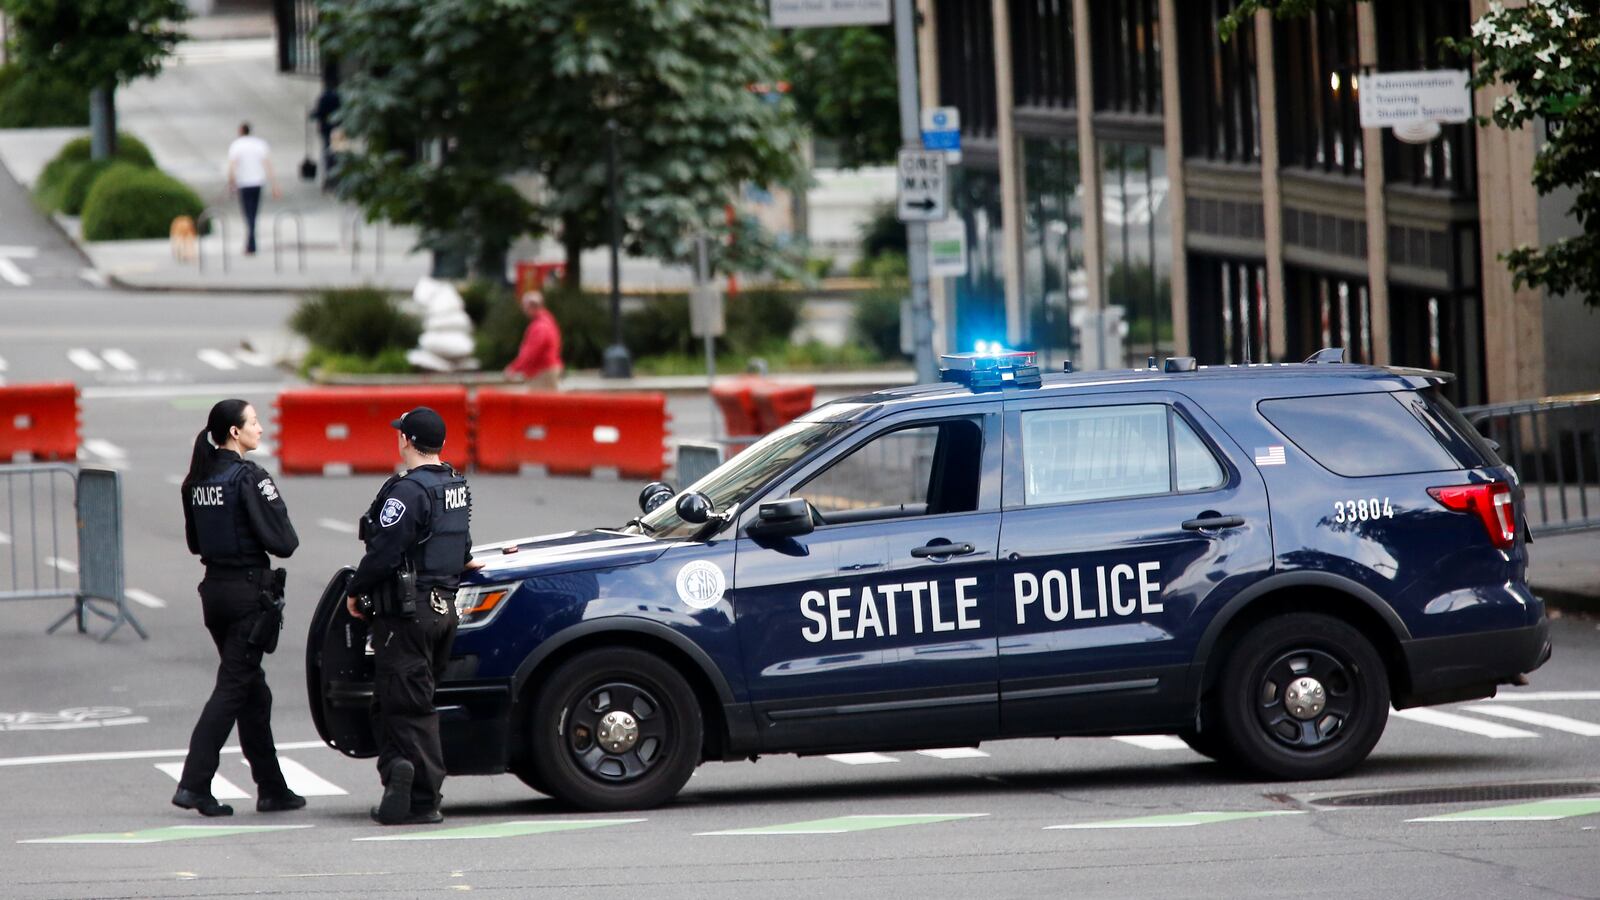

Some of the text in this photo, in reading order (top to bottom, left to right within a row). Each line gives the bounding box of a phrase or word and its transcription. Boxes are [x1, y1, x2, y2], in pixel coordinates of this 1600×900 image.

[903, 158, 938, 172] ONE
[904, 178, 940, 190] WAY
[192, 486, 224, 506] POLICE
[445, 486, 467, 510] POLICE
[1334, 497, 1394, 523] 33804
[800, 577, 981, 643] SEATTLE
[1013, 561, 1164, 625] POLICE
